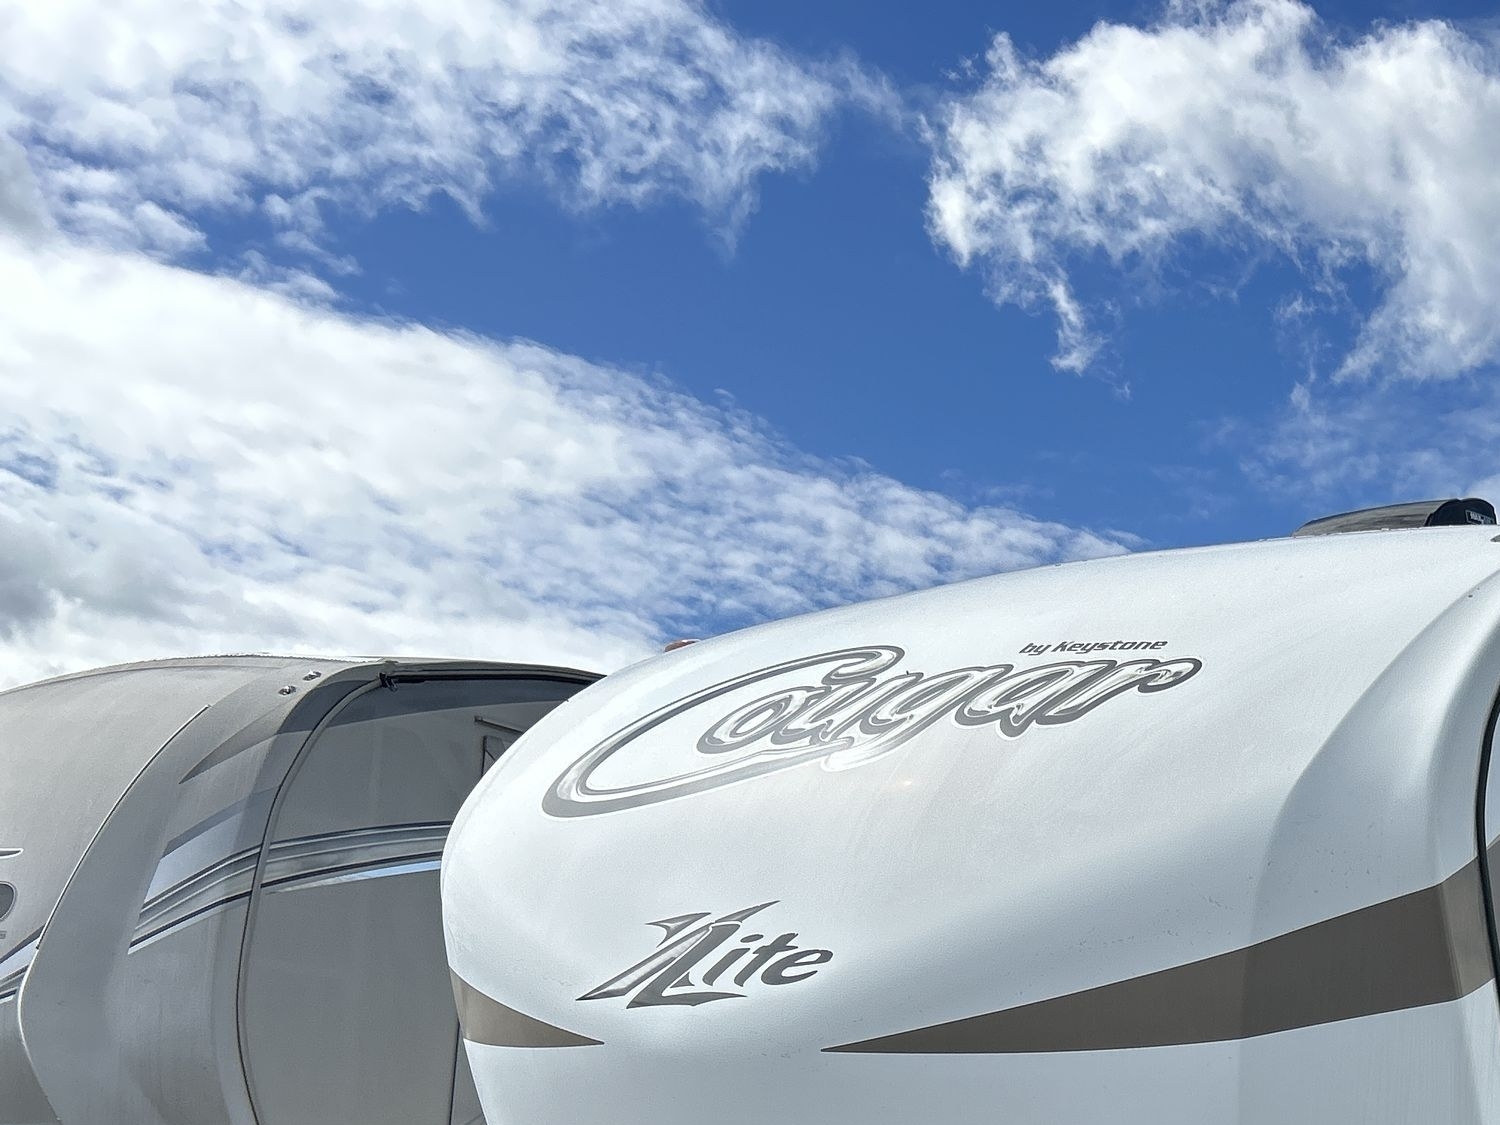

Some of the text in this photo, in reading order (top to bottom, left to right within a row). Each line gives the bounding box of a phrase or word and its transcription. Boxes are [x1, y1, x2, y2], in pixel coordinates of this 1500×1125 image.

[1019, 640, 1168, 656] by Keystone
[542, 646, 1202, 818] Cougar
